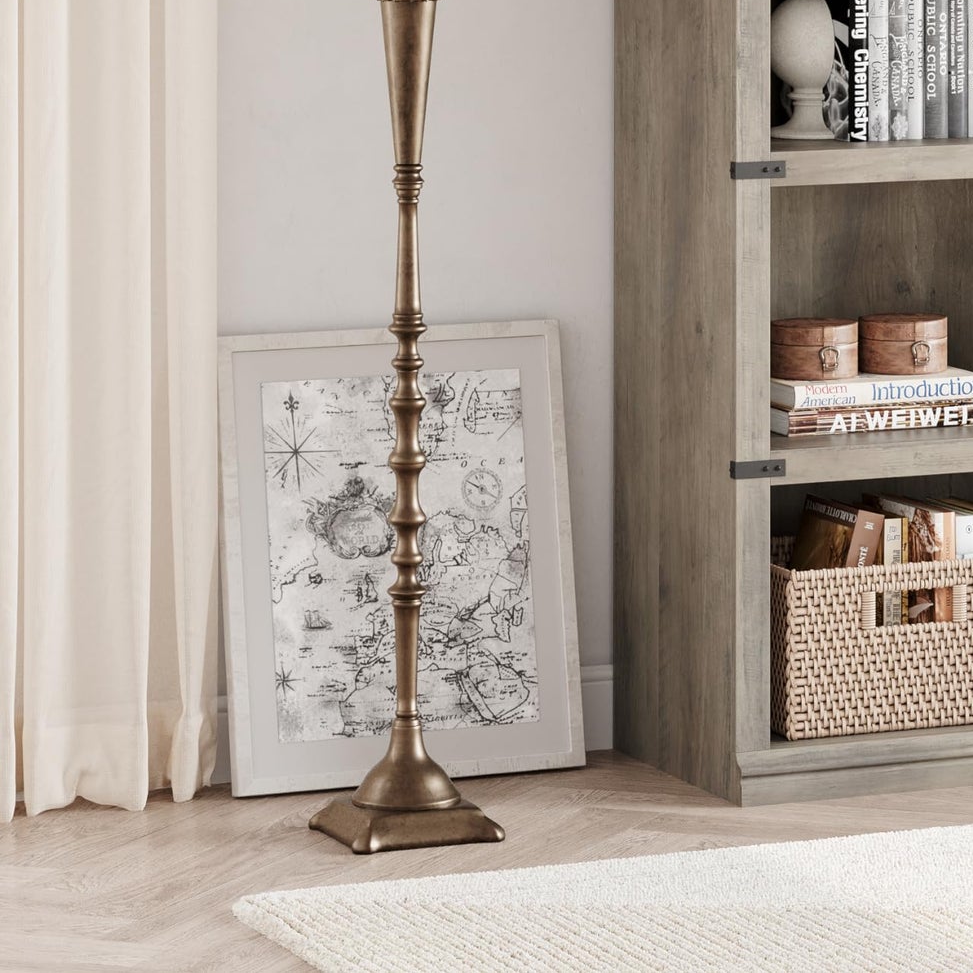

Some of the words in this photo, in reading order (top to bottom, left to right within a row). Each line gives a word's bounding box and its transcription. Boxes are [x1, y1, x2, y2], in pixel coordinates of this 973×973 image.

[939, 12, 947, 76] ONTARIO
[850, 49, 869, 141] Chemistry
[907, 50, 915, 103] SCHOOL
[926, 44, 936, 101] SCHOOL
[956, 55, 965, 94] Nation
[801, 396, 856, 407] American
[805, 384, 848, 396] Modern
[865, 405, 969, 431] WEIWEI
